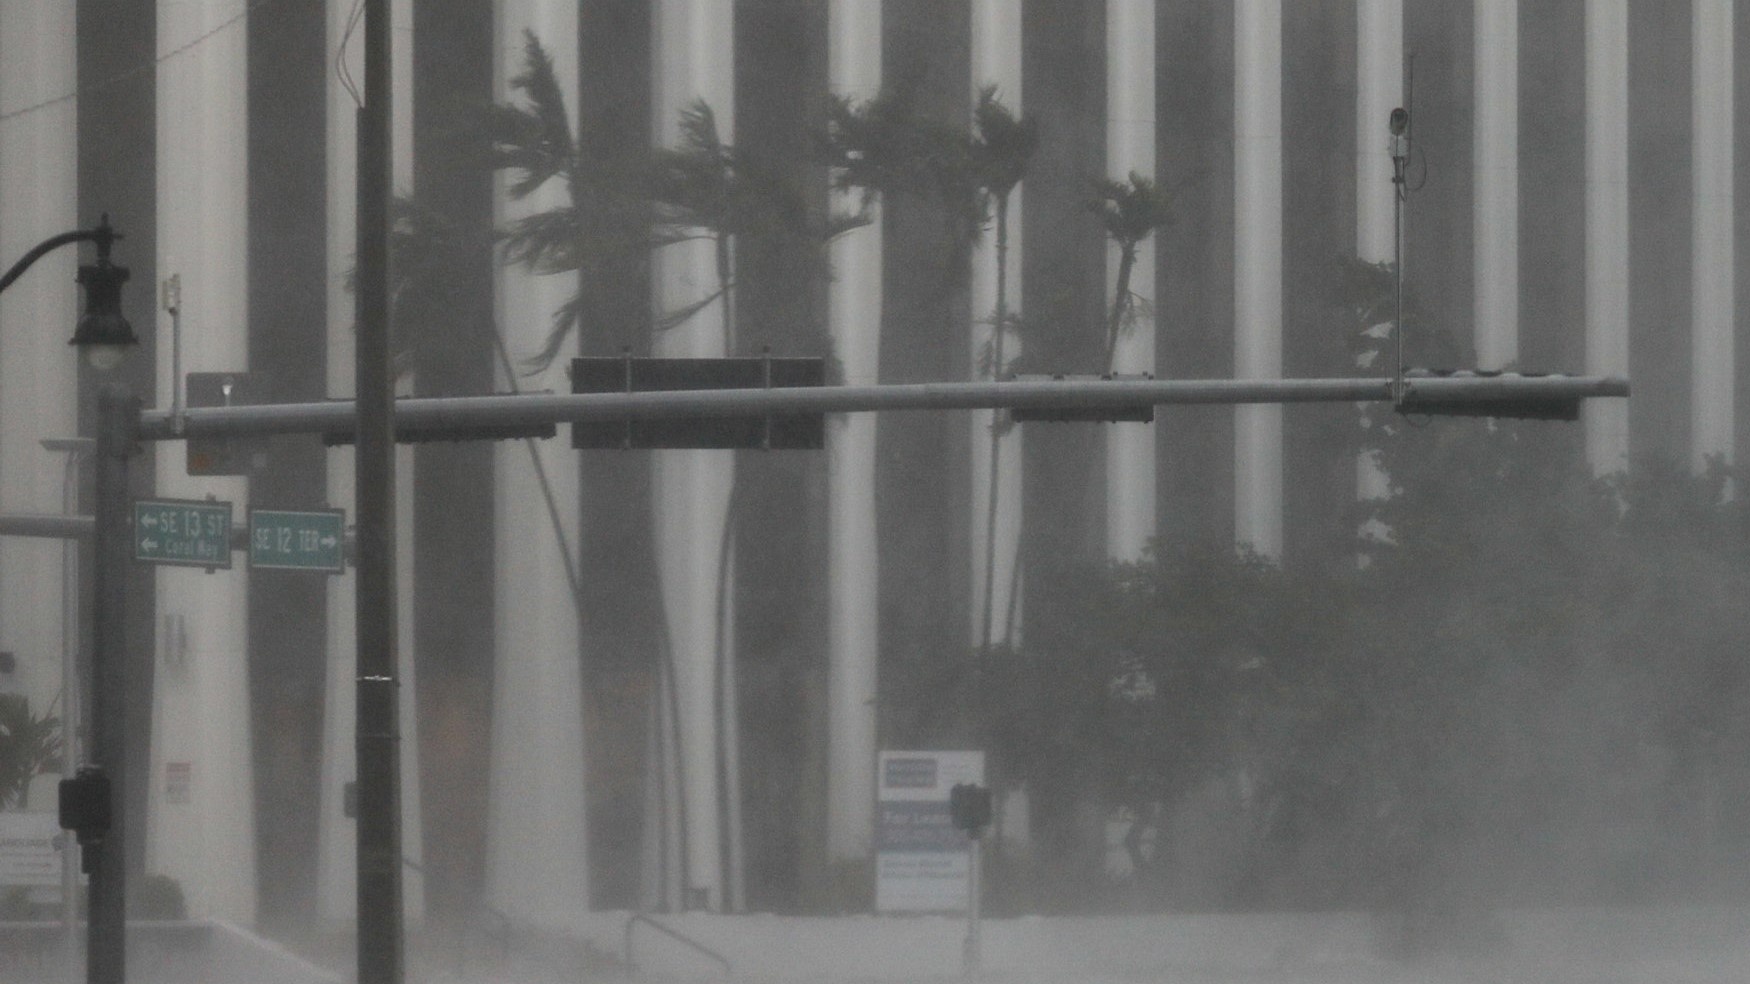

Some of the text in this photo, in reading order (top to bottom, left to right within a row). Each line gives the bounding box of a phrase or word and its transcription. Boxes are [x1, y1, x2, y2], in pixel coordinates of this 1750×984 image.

[160, 510, 225, 538] SE 13 ST
[255, 526, 319, 553] SE 12 TER
